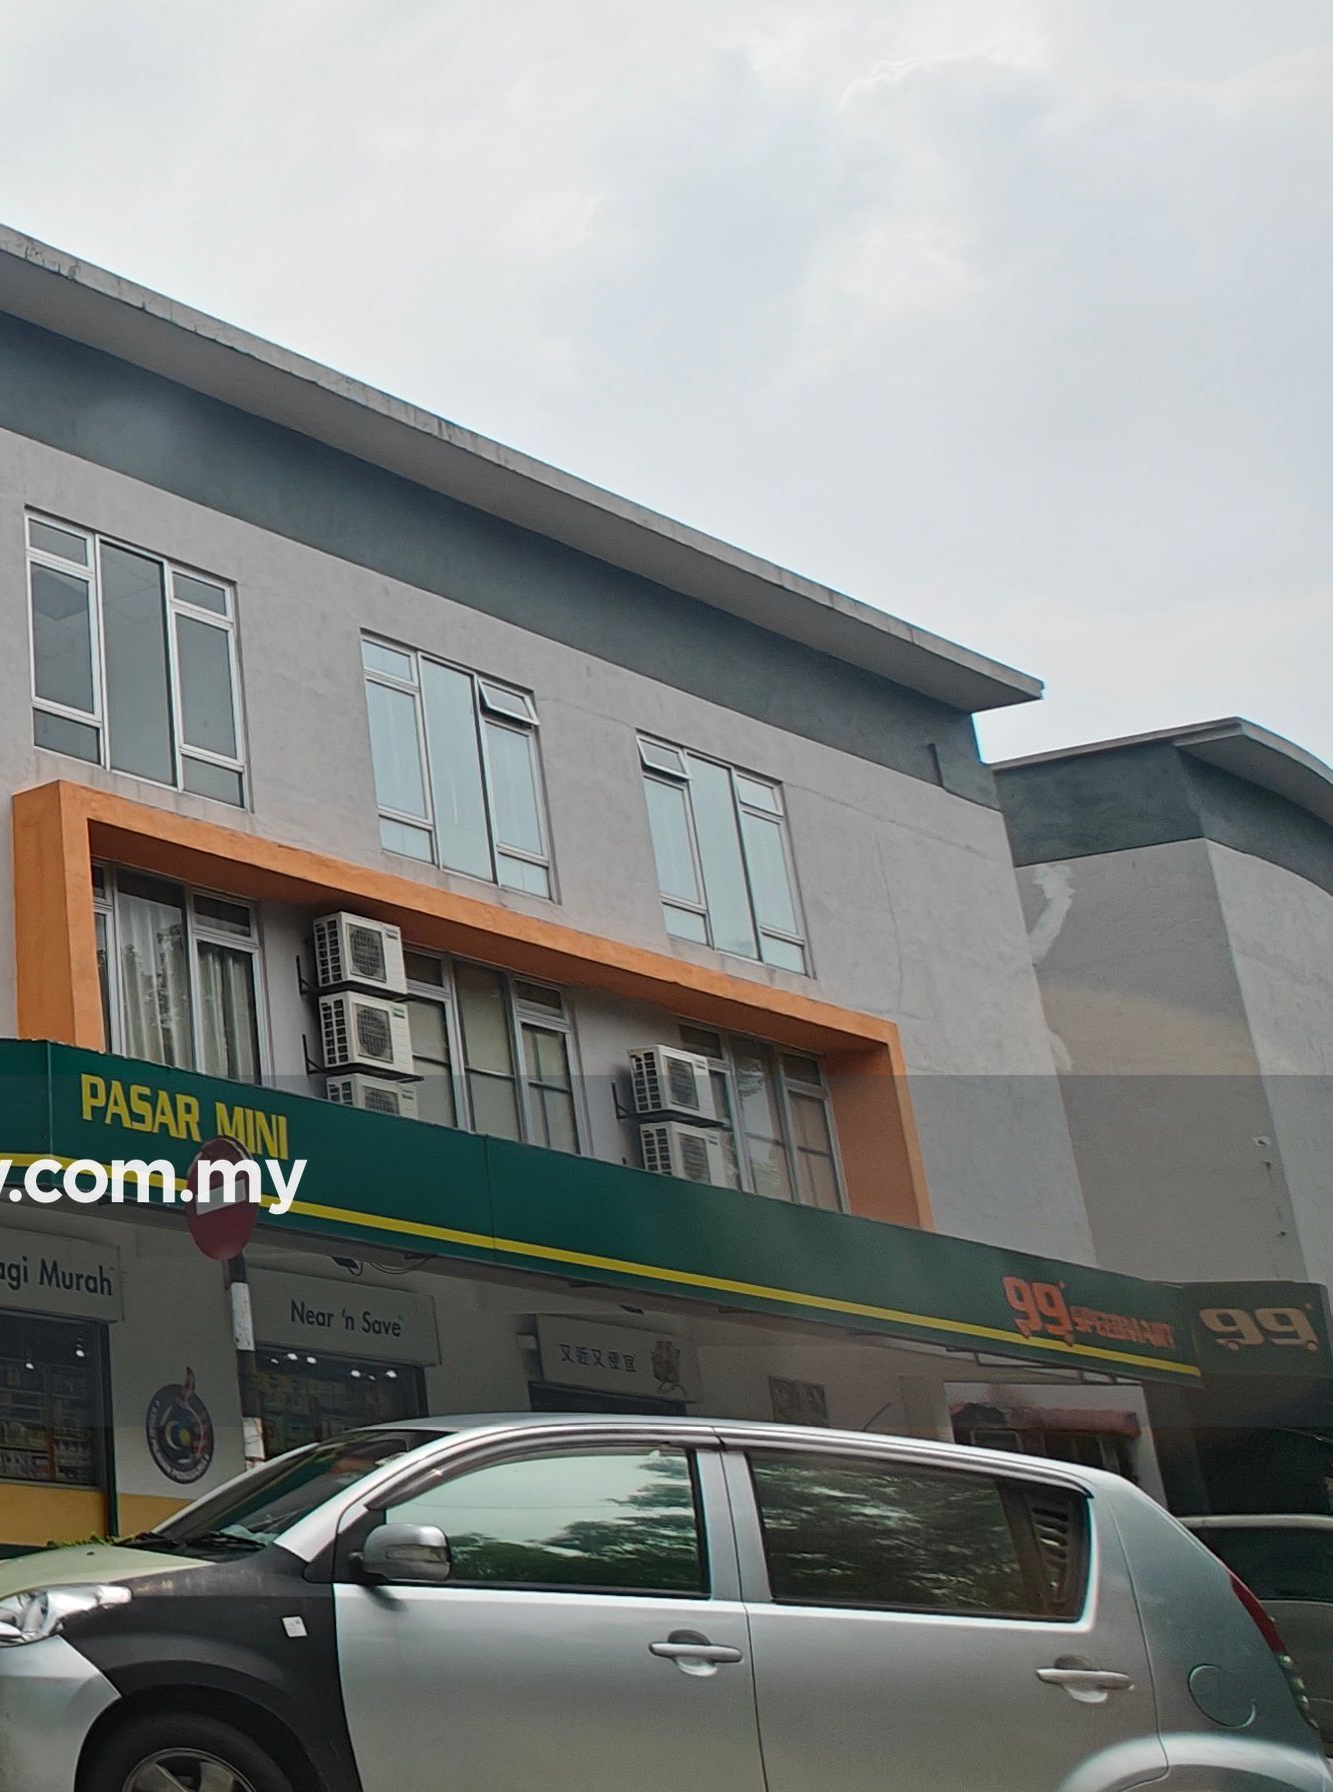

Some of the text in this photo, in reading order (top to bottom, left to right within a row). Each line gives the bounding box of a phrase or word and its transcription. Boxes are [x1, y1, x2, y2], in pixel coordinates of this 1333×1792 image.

[81, 1073, 289, 1160] PASAR MINI
[39, 1257, 113, 1296] Murah
[290, 1298, 335, 1328] Near
[361, 1310, 402, 1337] Save
[1002, 1275, 1074, 1348] 99
[1199, 1302, 1319, 1351] 99
